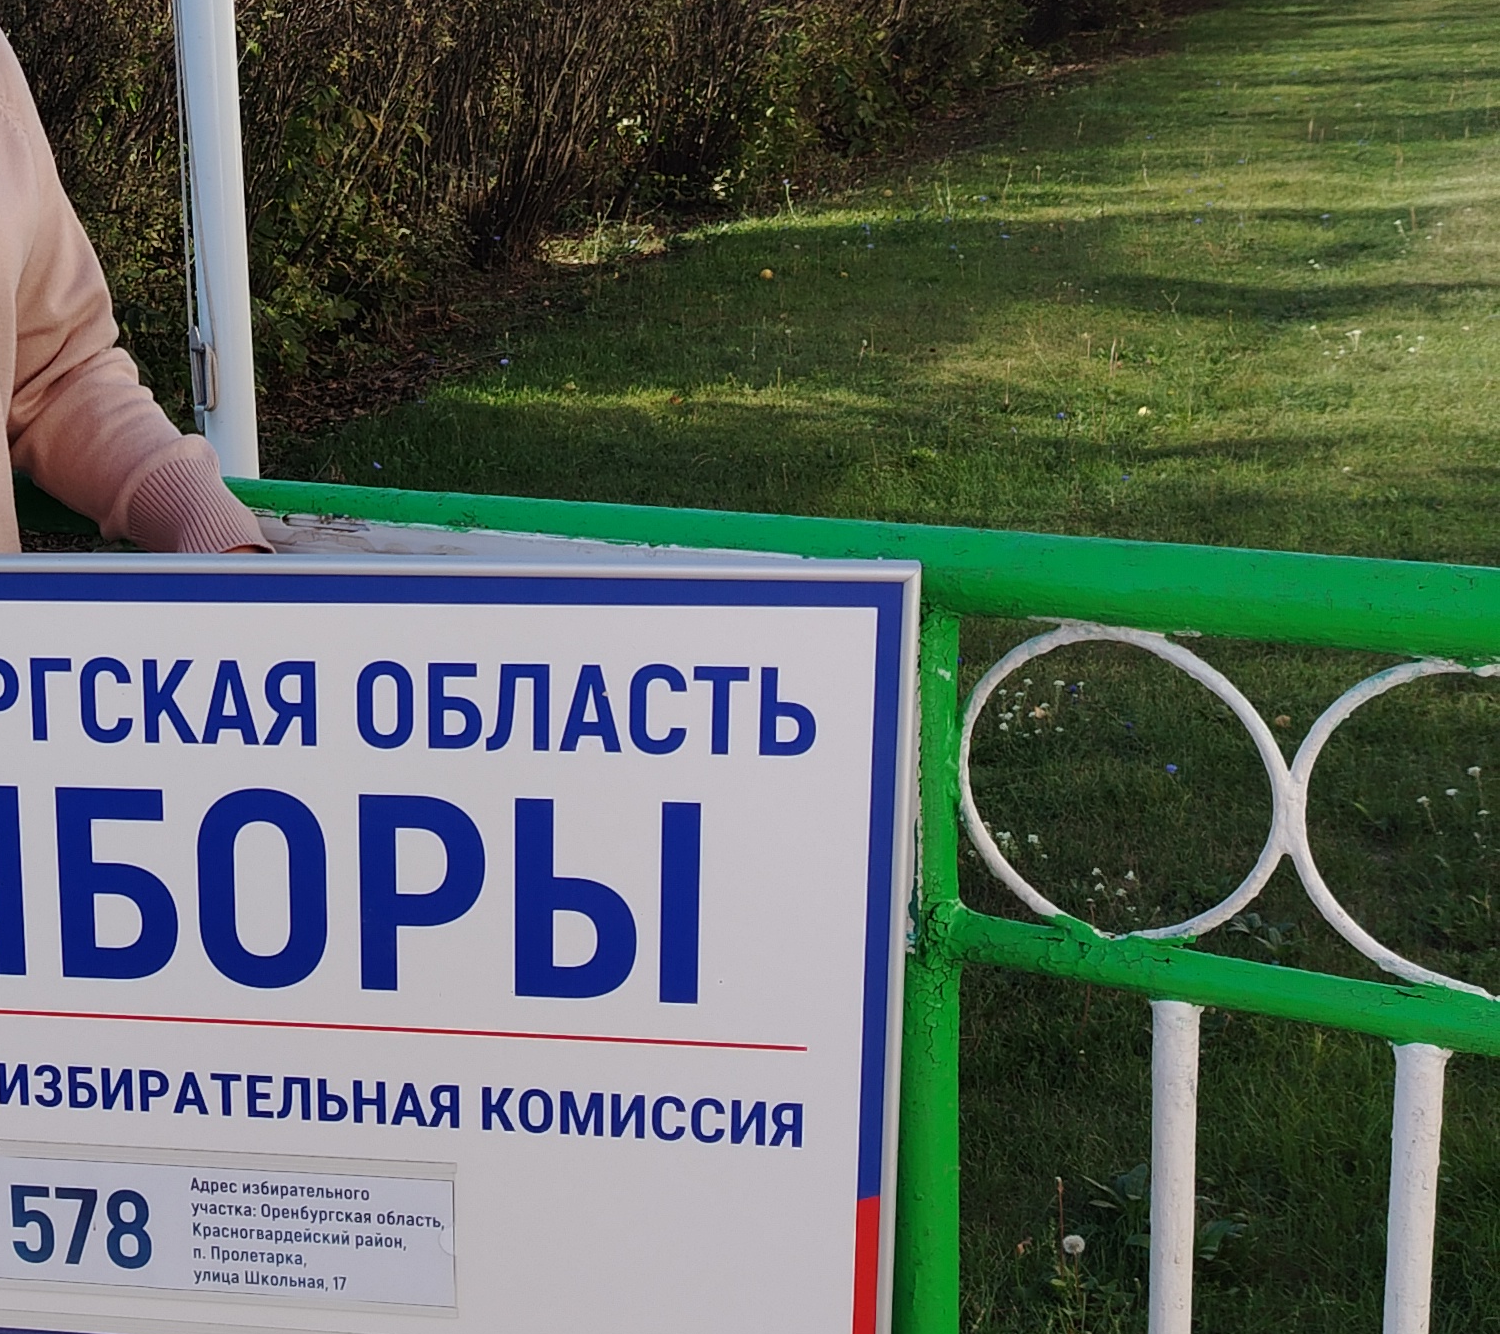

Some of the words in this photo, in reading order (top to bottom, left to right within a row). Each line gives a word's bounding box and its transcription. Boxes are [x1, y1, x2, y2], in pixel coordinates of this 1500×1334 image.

[355, 657, 818, 759] ОБЛАСТЬ
[485, 1087, 806, 1150] КОМИССИЯ
[191, 1177, 237, 1195] Адрес
[242, 1181, 370, 1203] избирательного
[10, 1184, 153, 1269] 578
[191, 1201, 256, 1219] участка:
[261, 1204, 371, 1226] Оренбургская
[376, 1210, 445, 1231] область,
[192, 1223, 350, 1248] Красногвардейский
[356, 1233, 407, 1251] район,
[194, 1248, 206, 1260] п.
[210, 1246, 308, 1268] Пролетарка,
[194, 1269, 240, 1287] улица
[244, 1270, 328, 1292] Школьная,
[333, 1276, 346, 1291] 17
